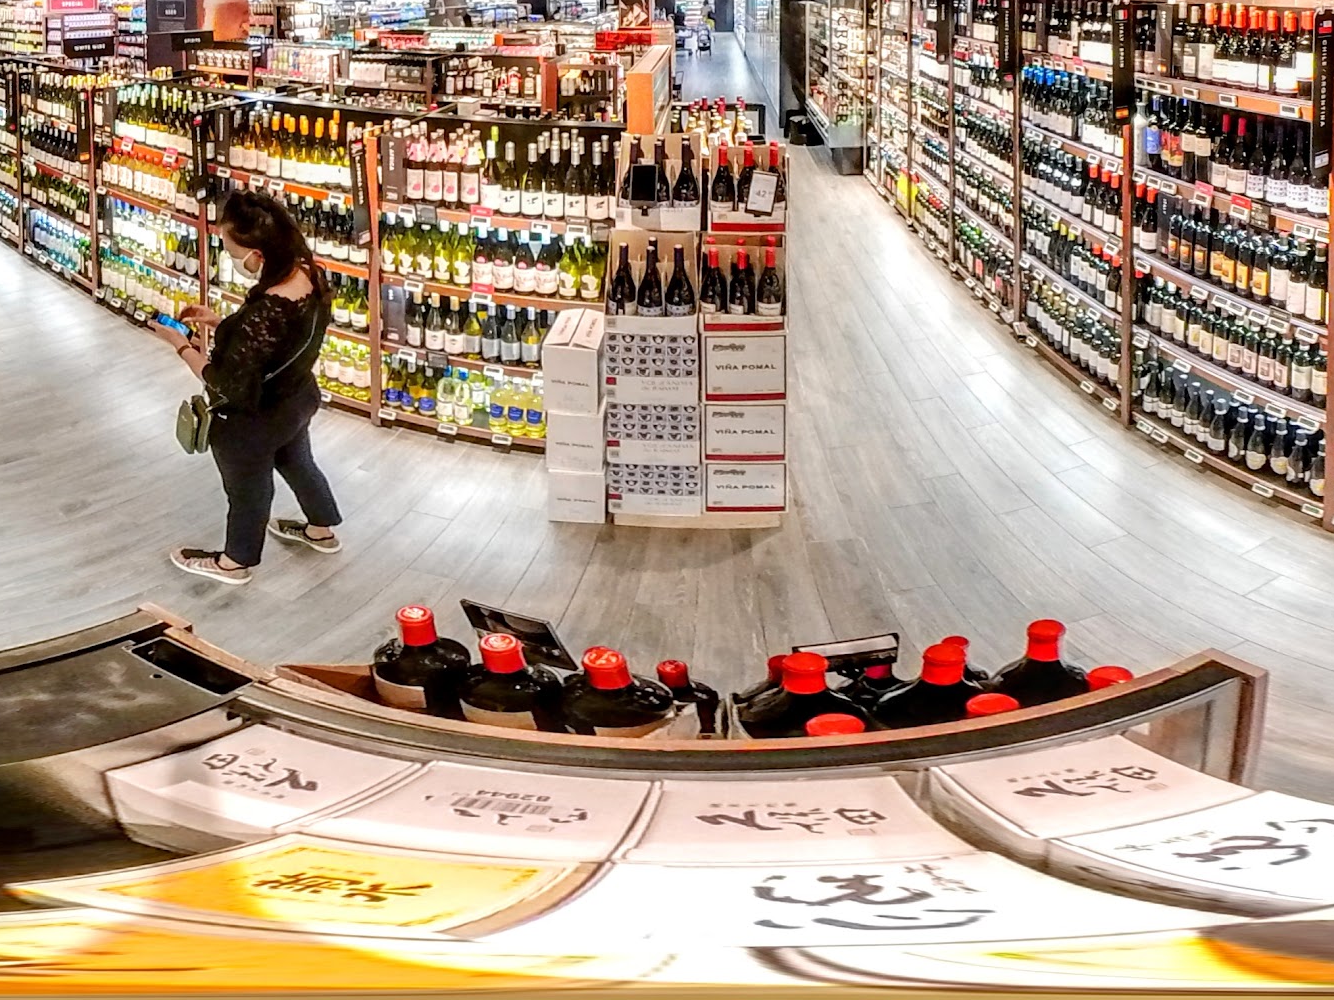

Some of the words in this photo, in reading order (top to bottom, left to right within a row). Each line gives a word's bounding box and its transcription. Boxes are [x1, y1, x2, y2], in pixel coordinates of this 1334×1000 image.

[835, 16, 850, 68] CRAFT
[836, 81, 850, 123] BEER
[1319, 77, 1328, 128] ARGENTINA
[473, 789, 551, 803] 82944
